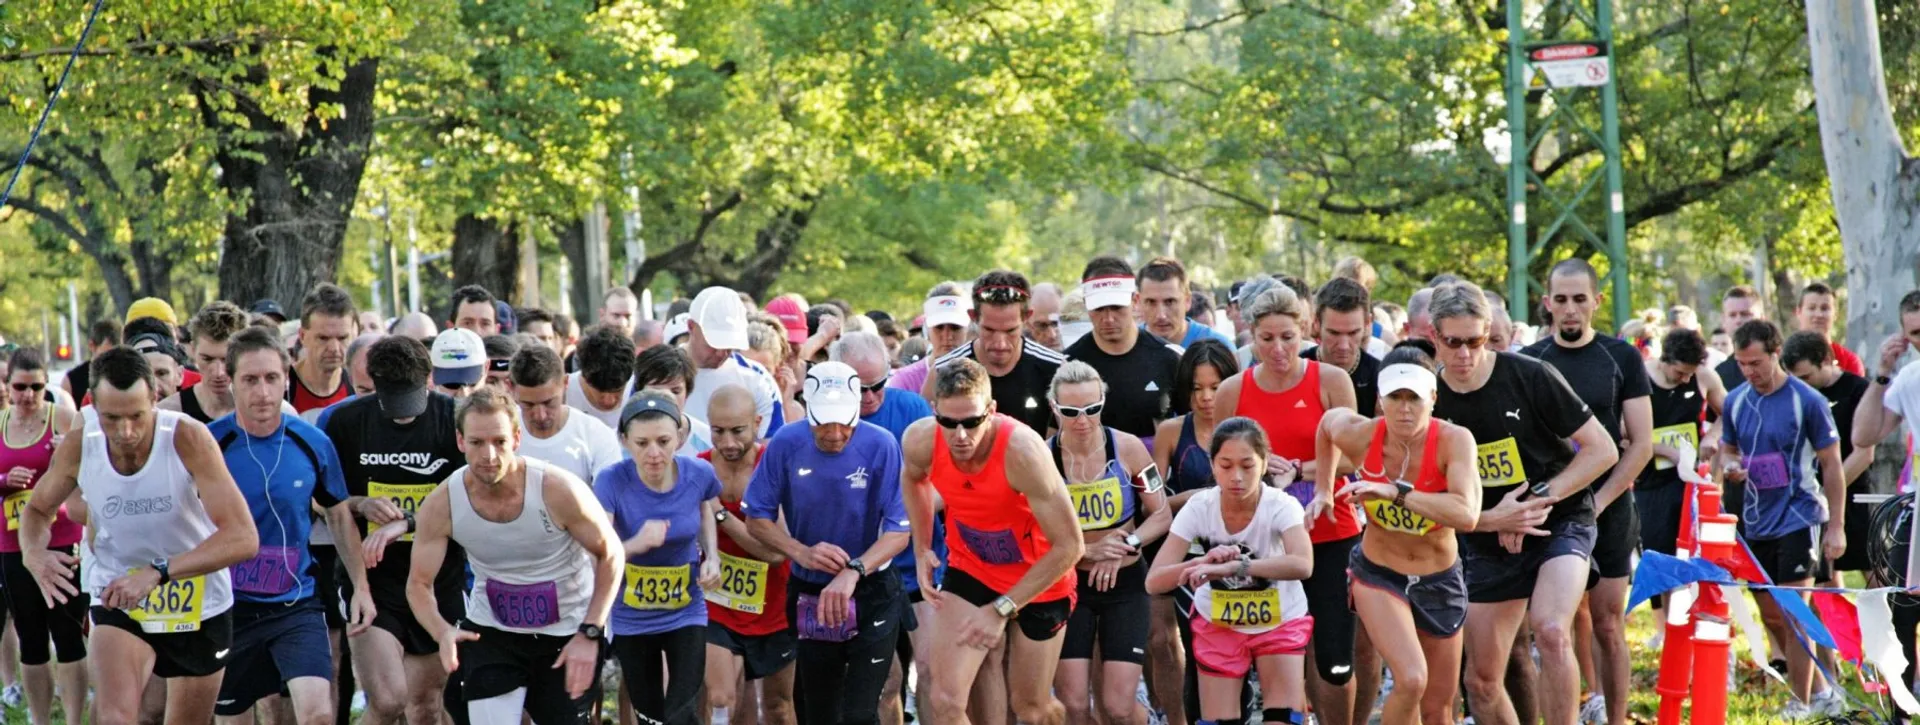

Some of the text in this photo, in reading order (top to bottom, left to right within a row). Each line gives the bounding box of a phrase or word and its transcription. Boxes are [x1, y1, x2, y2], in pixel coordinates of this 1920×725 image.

[1542, 46, 1587, 59] DANGER
[360, 452, 431, 467] saucony
[123, 495, 172, 516] asics
[1071, 491, 1114, 522] 406
[235, 557, 286, 591] 6471
[719, 564, 757, 598] 265
[634, 577, 683, 603] 4334
[497, 593, 548, 625] 6569
[1221, 600, 1272, 625] 4266
[175, 623, 194, 631] 4362
